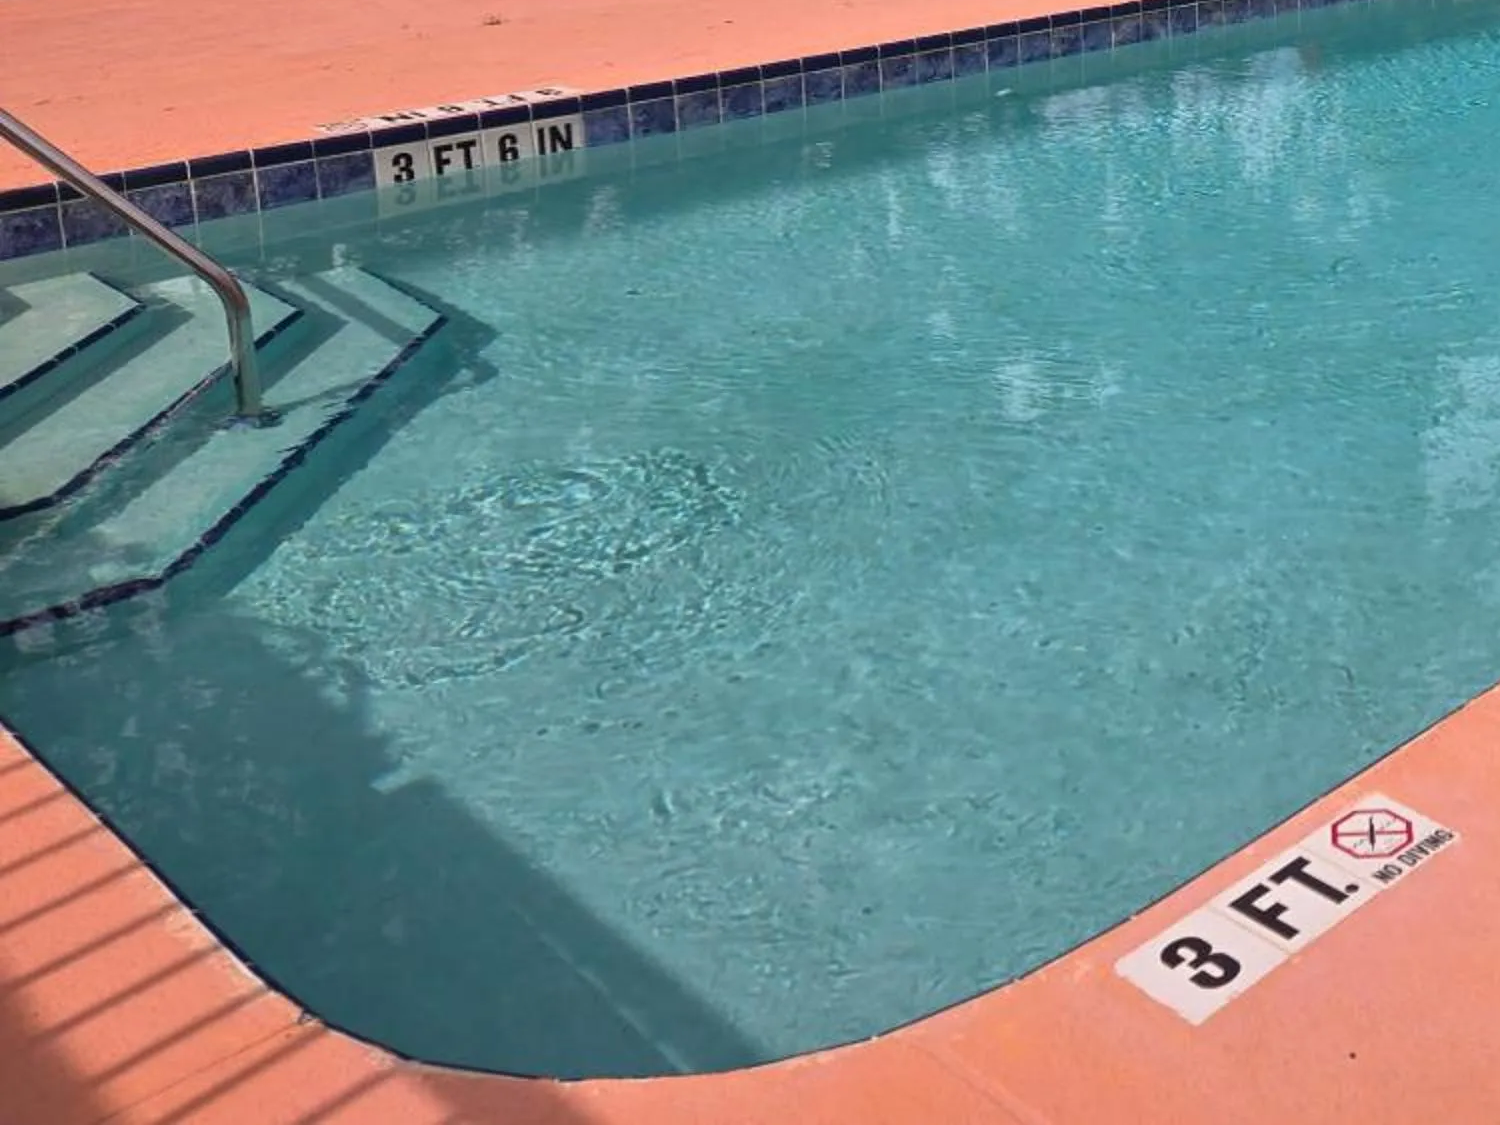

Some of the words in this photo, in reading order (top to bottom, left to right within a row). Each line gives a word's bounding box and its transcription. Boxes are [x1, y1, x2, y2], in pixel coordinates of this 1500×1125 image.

[391, 152, 415, 184] 3
[433, 138, 477, 176] FT
[498, 132, 519, 163] 6
[537, 122, 573, 157] IN
[1372, 863, 1403, 885] NO
[1397, 828, 1455, 868] DIVING
[1160, 936, 1242, 989] 3
[1228, 855, 1360, 941] FT.
